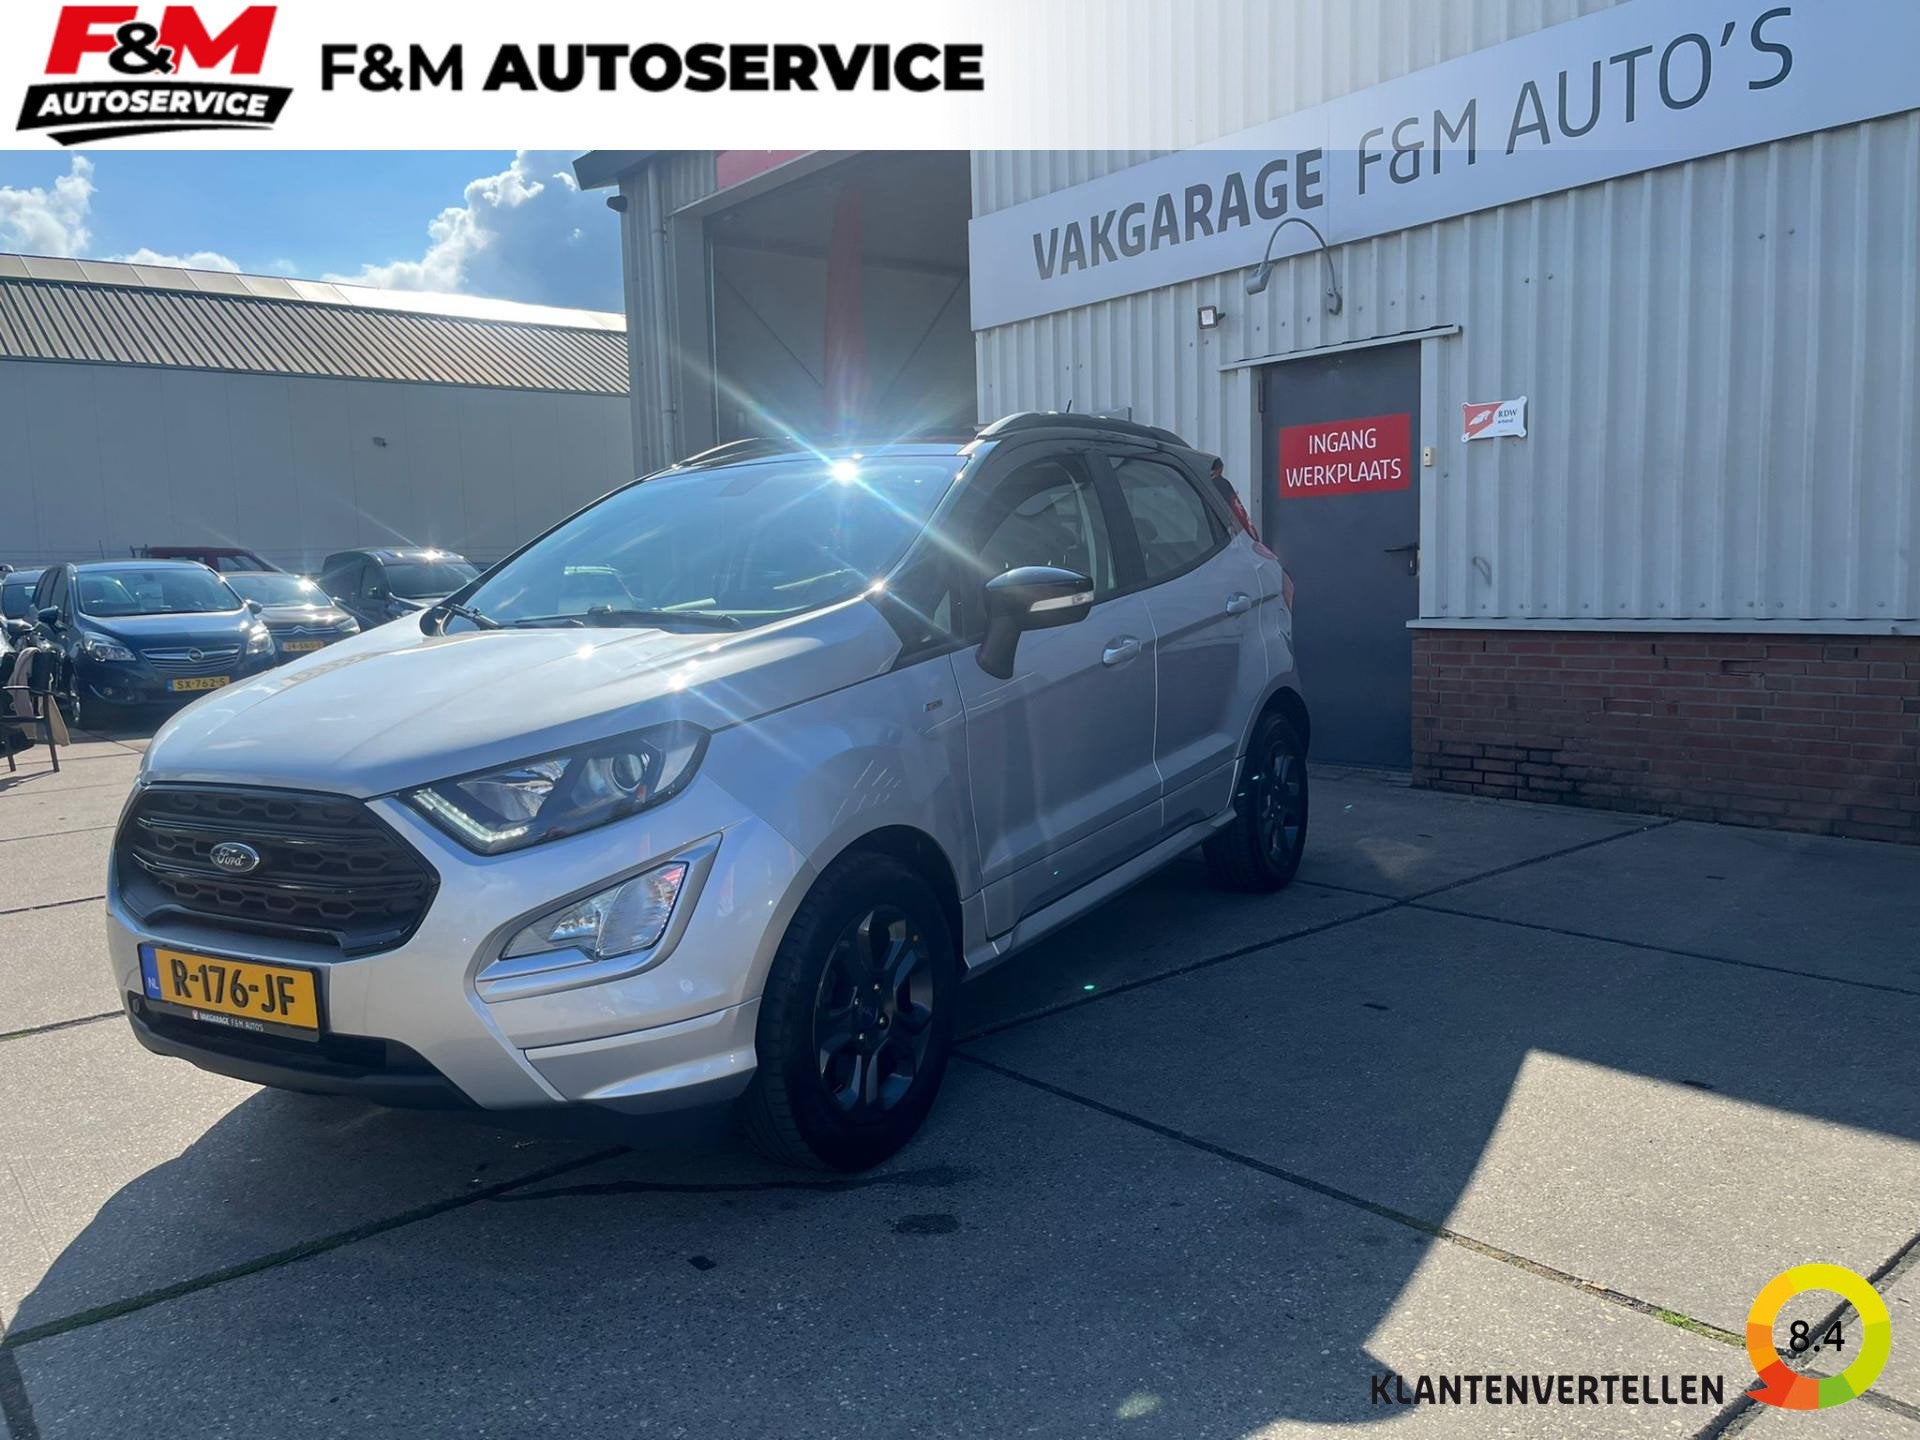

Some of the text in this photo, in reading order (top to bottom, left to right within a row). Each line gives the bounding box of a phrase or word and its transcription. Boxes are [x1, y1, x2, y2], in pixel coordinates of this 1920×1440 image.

[1032, 6, 1795, 281] VAKGARAGE F&M AUTO'S
[1497, 408, 1518, 418] RDW
[1308, 427, 1378, 455] INGANG
[1286, 457, 1402, 488] WERKPLAATS
[215, 846, 246, 867] Ford
[170, 958, 296, 1016] R-176-JF
